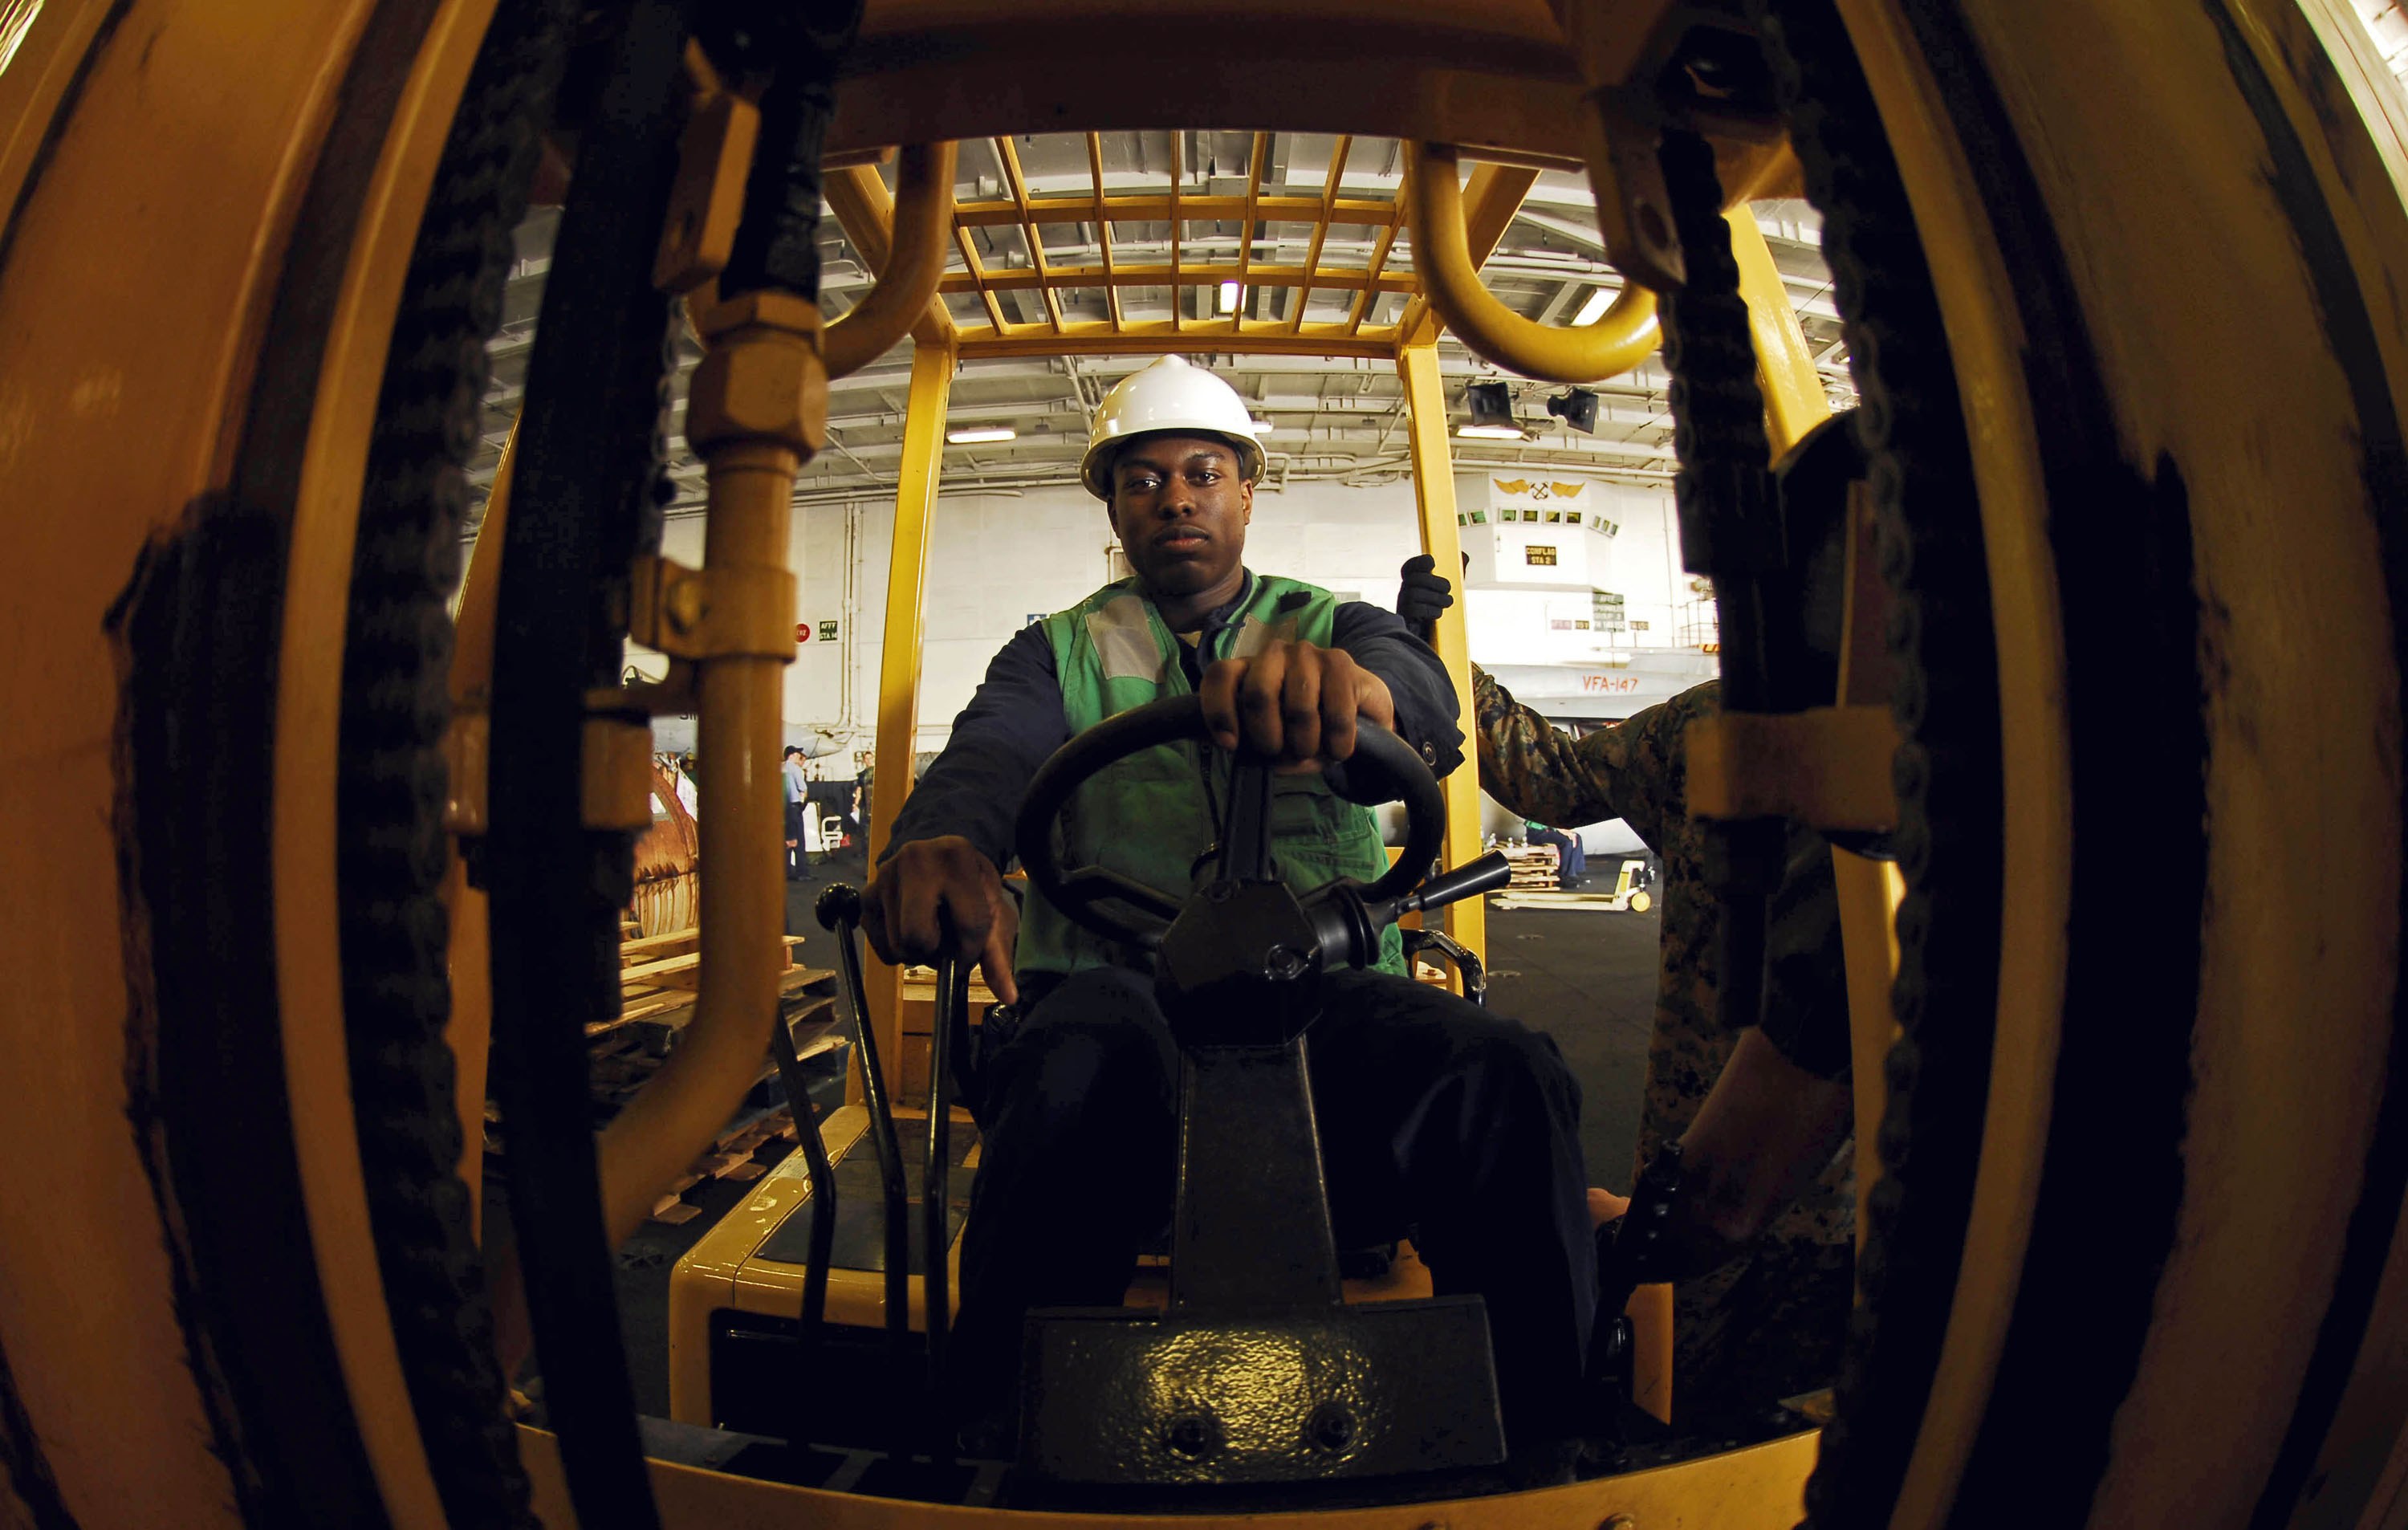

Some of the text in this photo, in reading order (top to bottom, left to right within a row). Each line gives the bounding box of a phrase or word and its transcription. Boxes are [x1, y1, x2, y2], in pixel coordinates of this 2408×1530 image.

[1526, 547, 1556, 555] CONFLAG
[1531, 555, 1544, 564] STA
[820, 622, 836, 630] AFFF
[820, 632, 831, 640] STA
[1582, 675, 1638, 692] VFA-147
